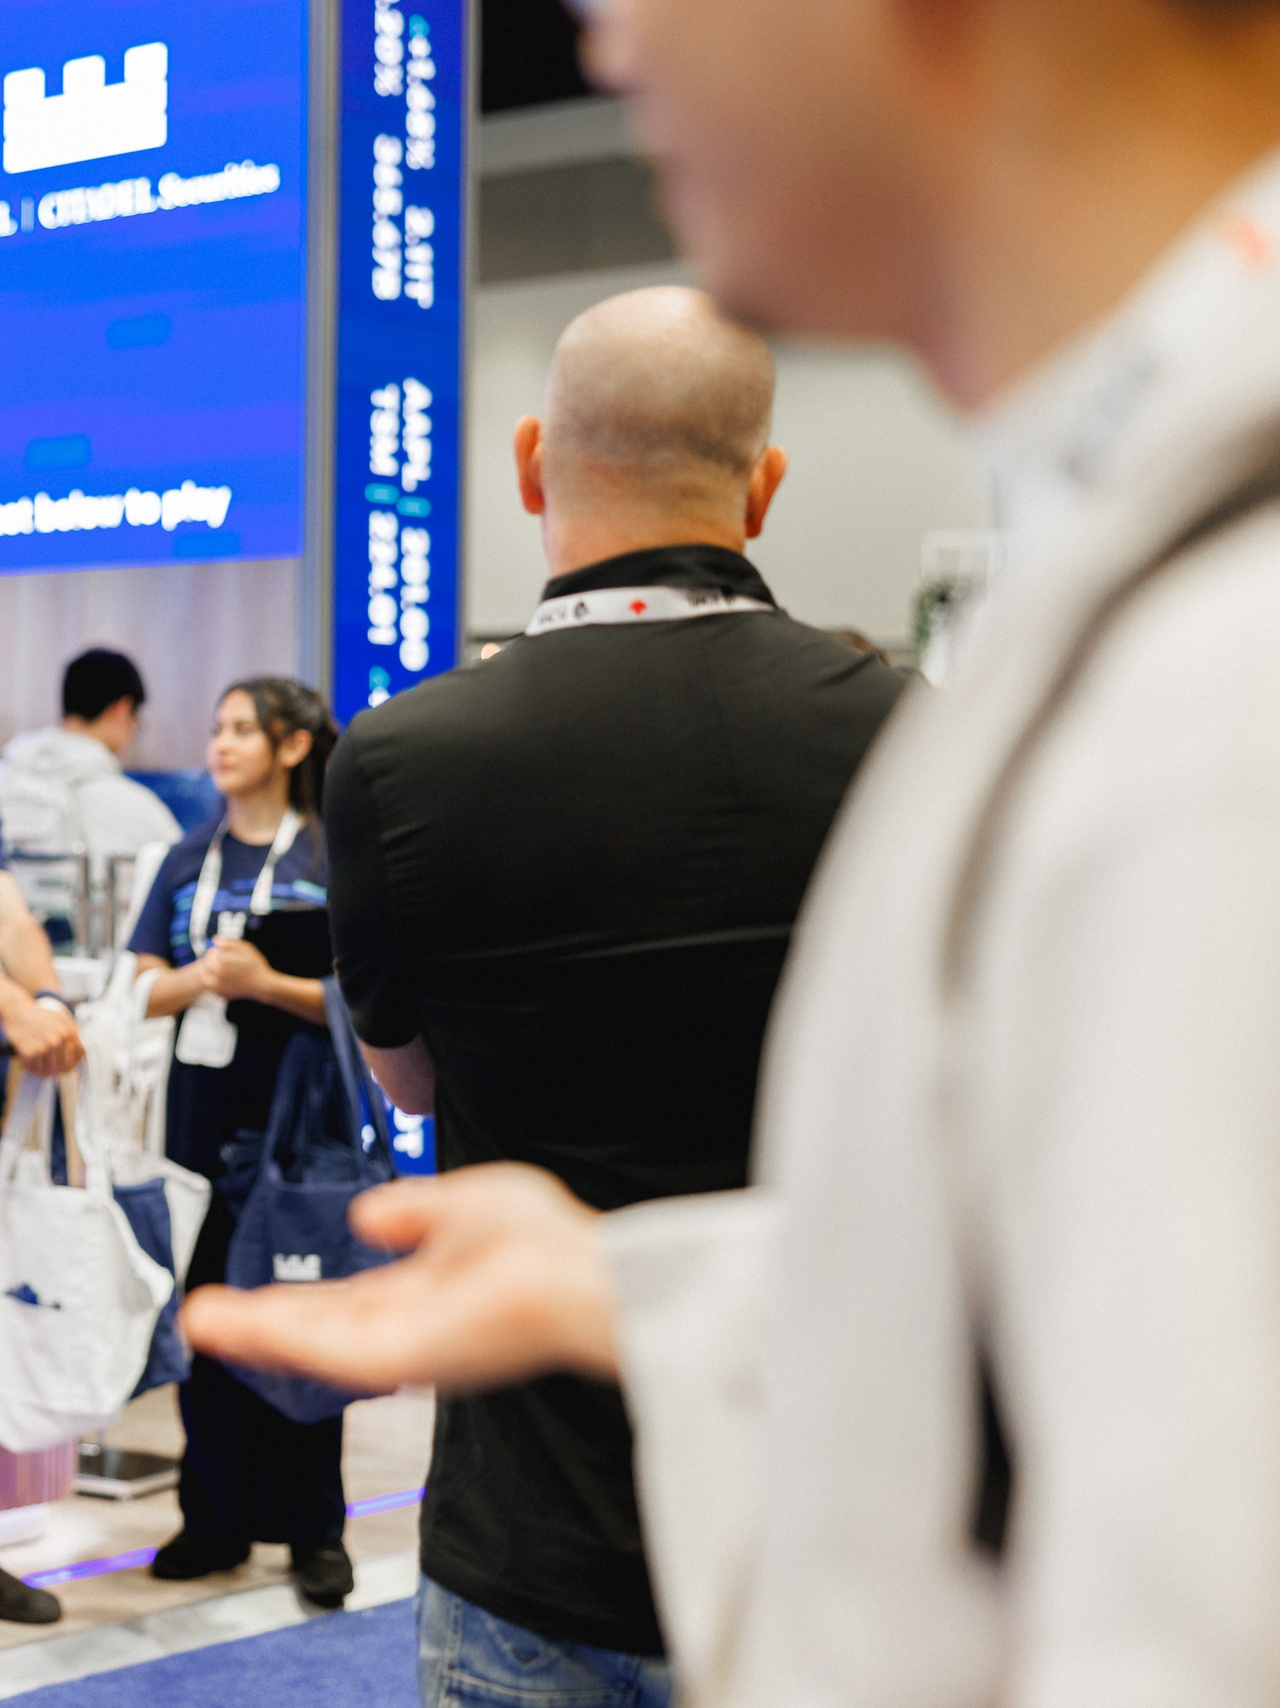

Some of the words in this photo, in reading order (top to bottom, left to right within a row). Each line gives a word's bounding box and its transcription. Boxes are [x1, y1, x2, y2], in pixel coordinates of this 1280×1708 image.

[401, 377, 432, 492] AAPL
[124, 487, 161, 526] to
[161, 480, 232, 531] play
